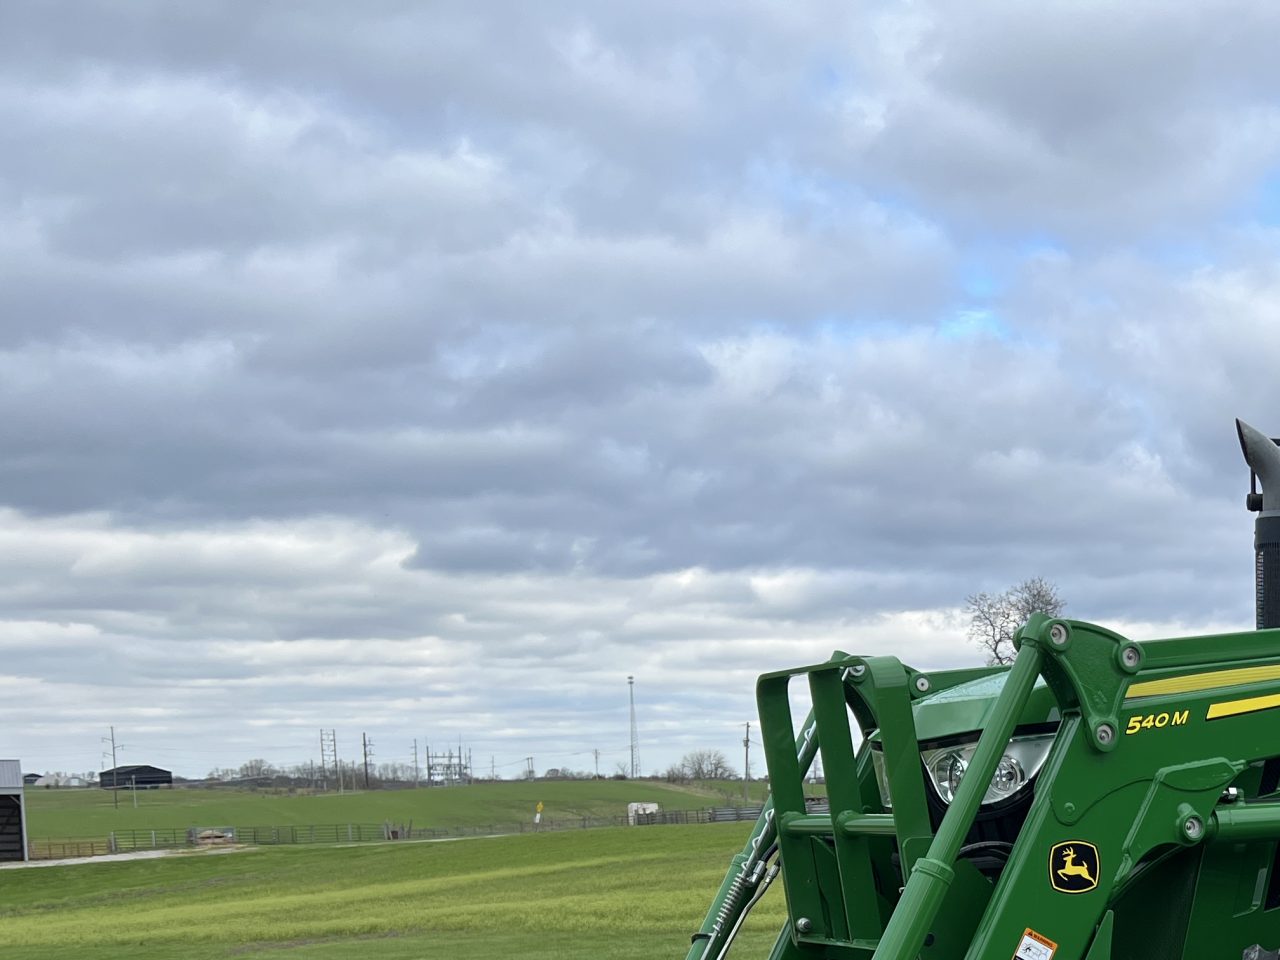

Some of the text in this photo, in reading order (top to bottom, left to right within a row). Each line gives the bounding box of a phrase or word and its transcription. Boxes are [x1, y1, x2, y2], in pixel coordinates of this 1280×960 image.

[1125, 710, 1190, 735] 540 M
[1034, 934, 1054, 948] WARNING
